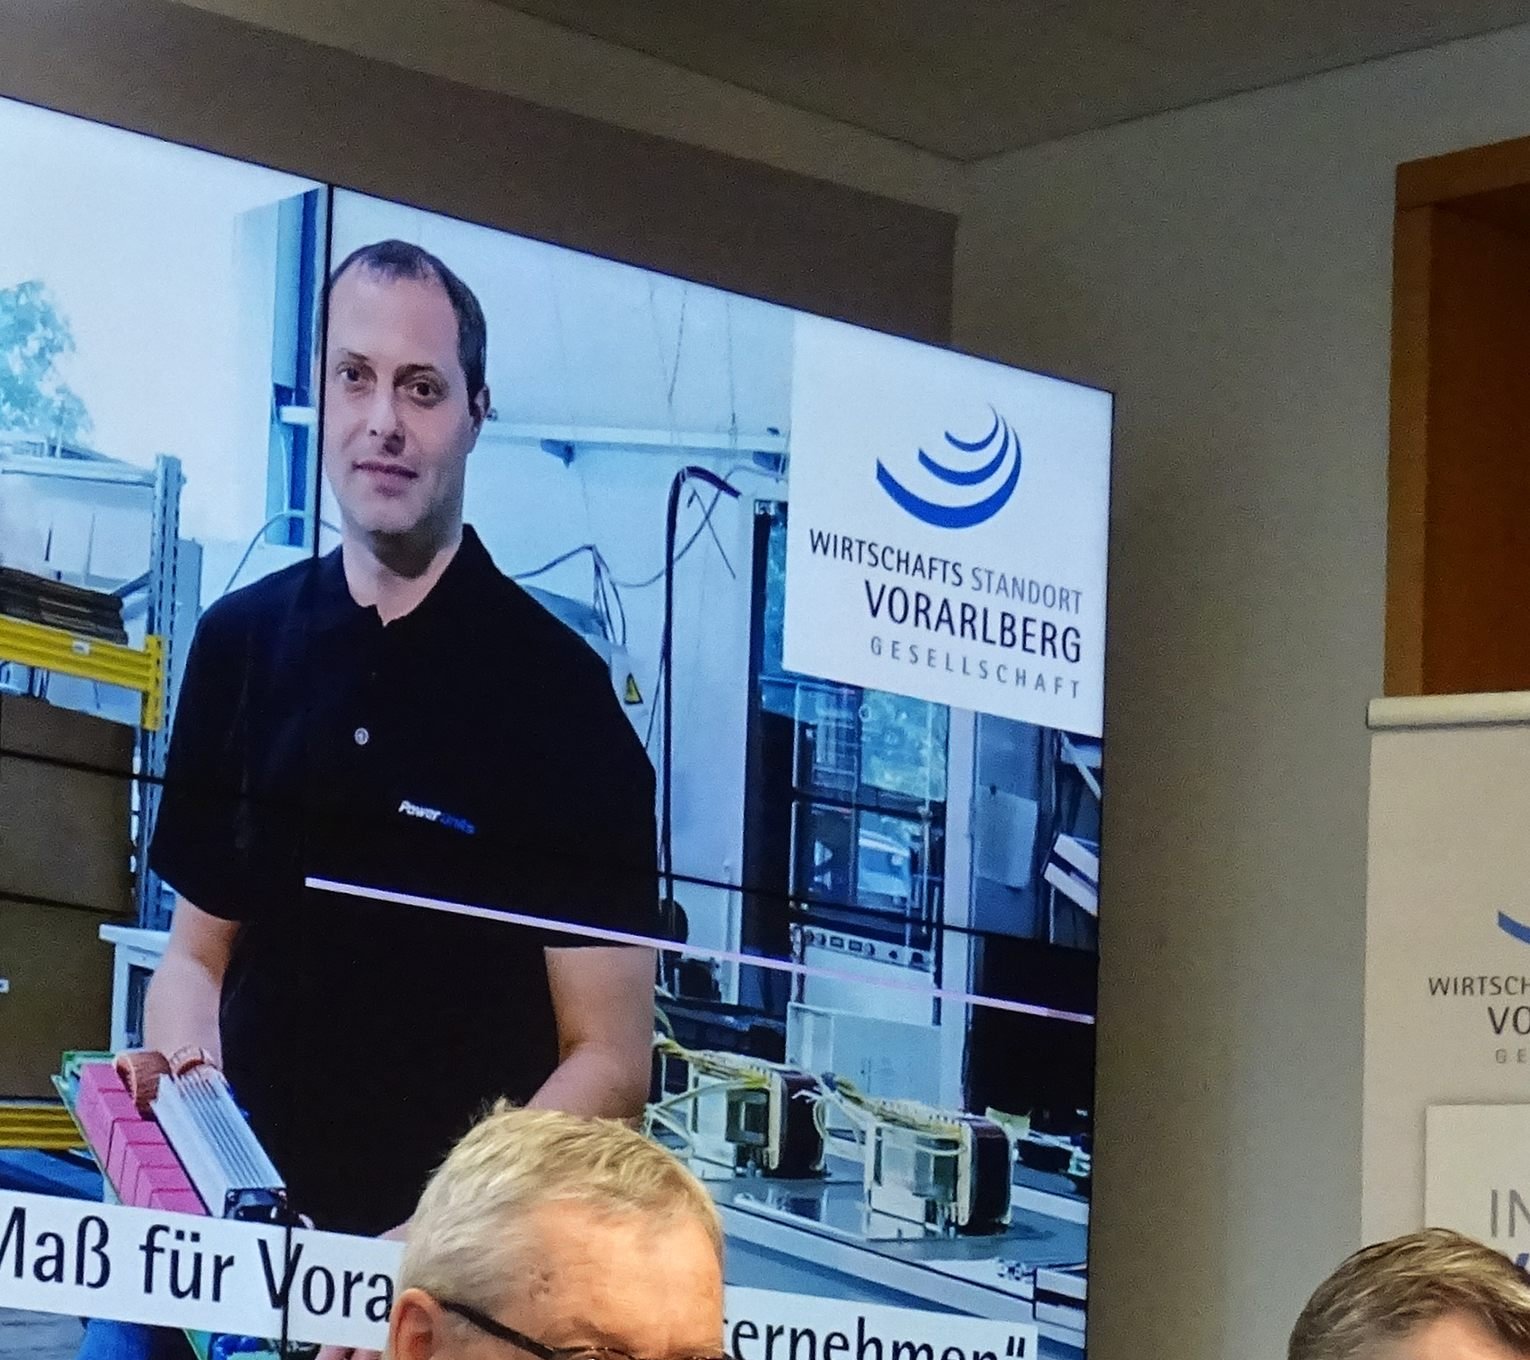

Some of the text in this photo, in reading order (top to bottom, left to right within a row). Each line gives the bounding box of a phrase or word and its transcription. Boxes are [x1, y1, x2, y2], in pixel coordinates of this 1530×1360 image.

[809, 528, 1082, 614] WIRTSCHAFTS STANDORT
[864, 579, 1081, 663] VORARLBERG
[870, 636, 1080, 699] GESELLSCHAFT
[139, 1224, 235, 1303] für
